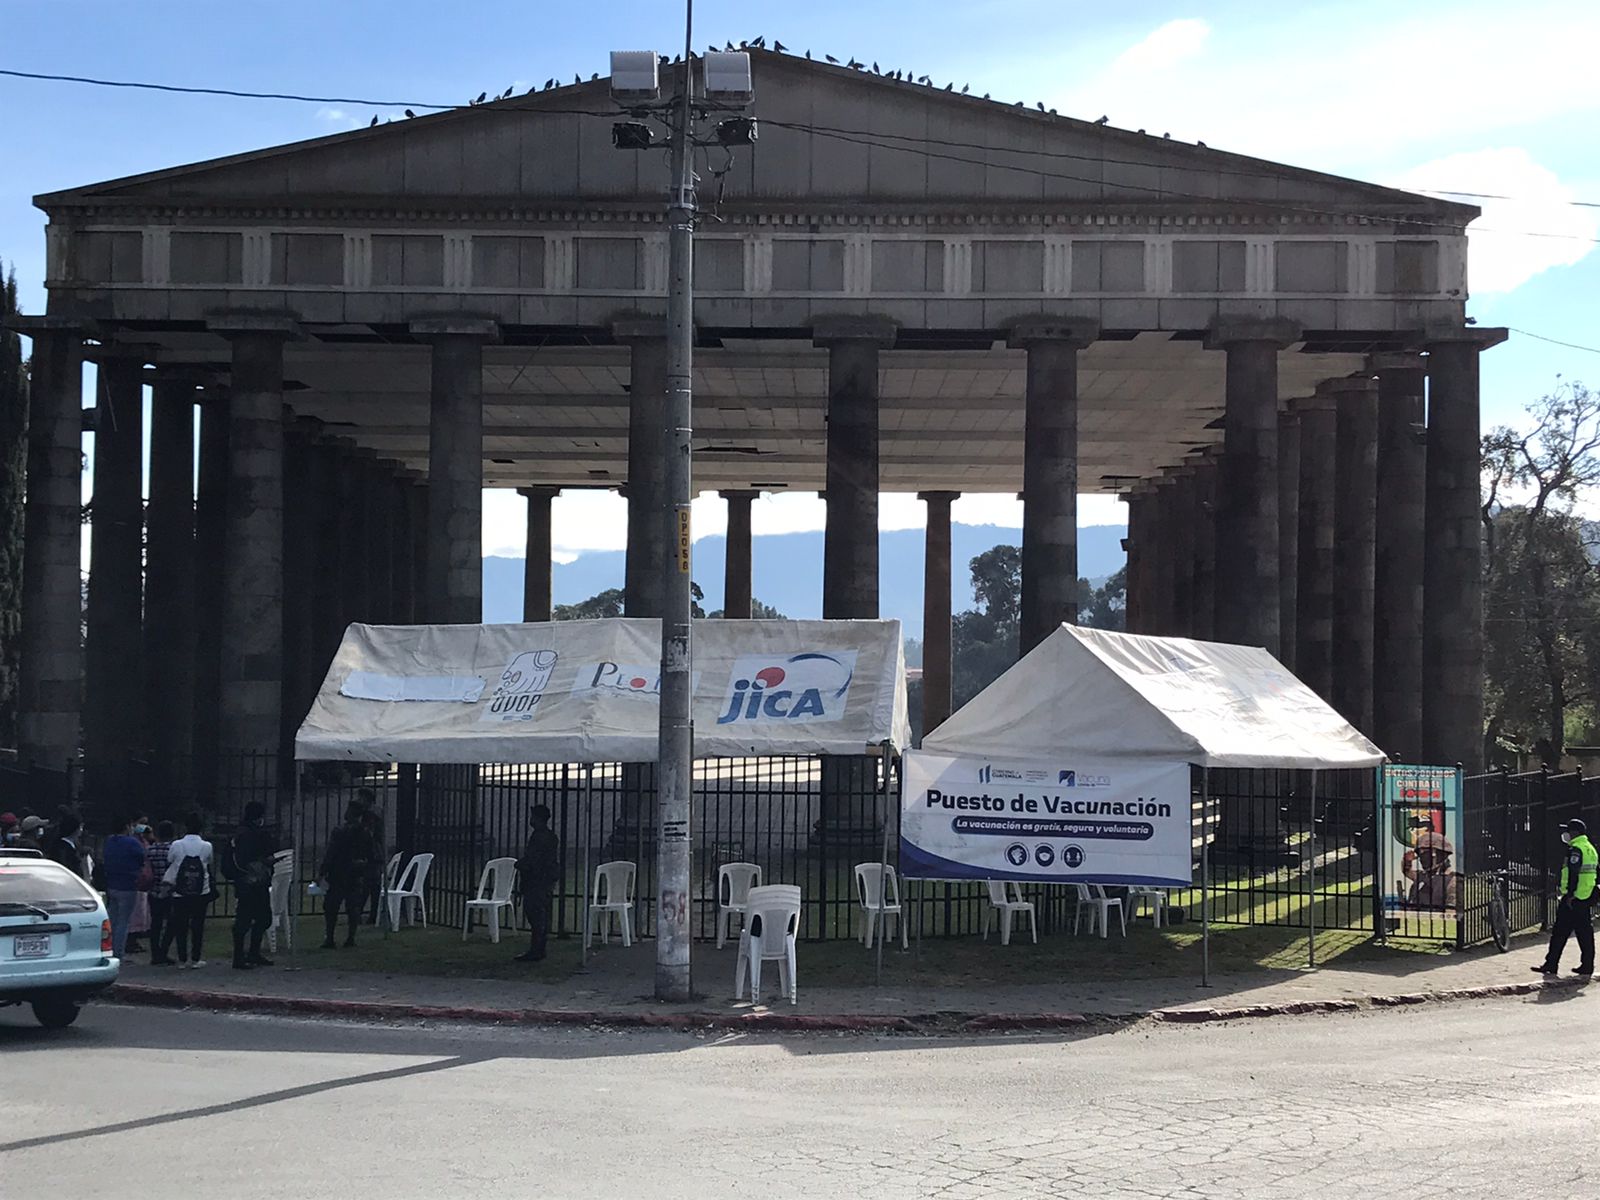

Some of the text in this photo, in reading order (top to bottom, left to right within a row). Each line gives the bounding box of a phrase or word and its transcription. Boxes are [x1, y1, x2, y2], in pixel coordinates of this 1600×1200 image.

[926, 789, 1171, 817] Puesto de Vacunación
[956, 819, 968, 828] La
[969, 820, 1021, 830] vacunación
[1033, 822, 1062, 832] gratis,
[1063, 824, 1093, 833] segura
[1095, 826, 1102, 834] y
[1103, 824, 1149, 835] voluntaria
